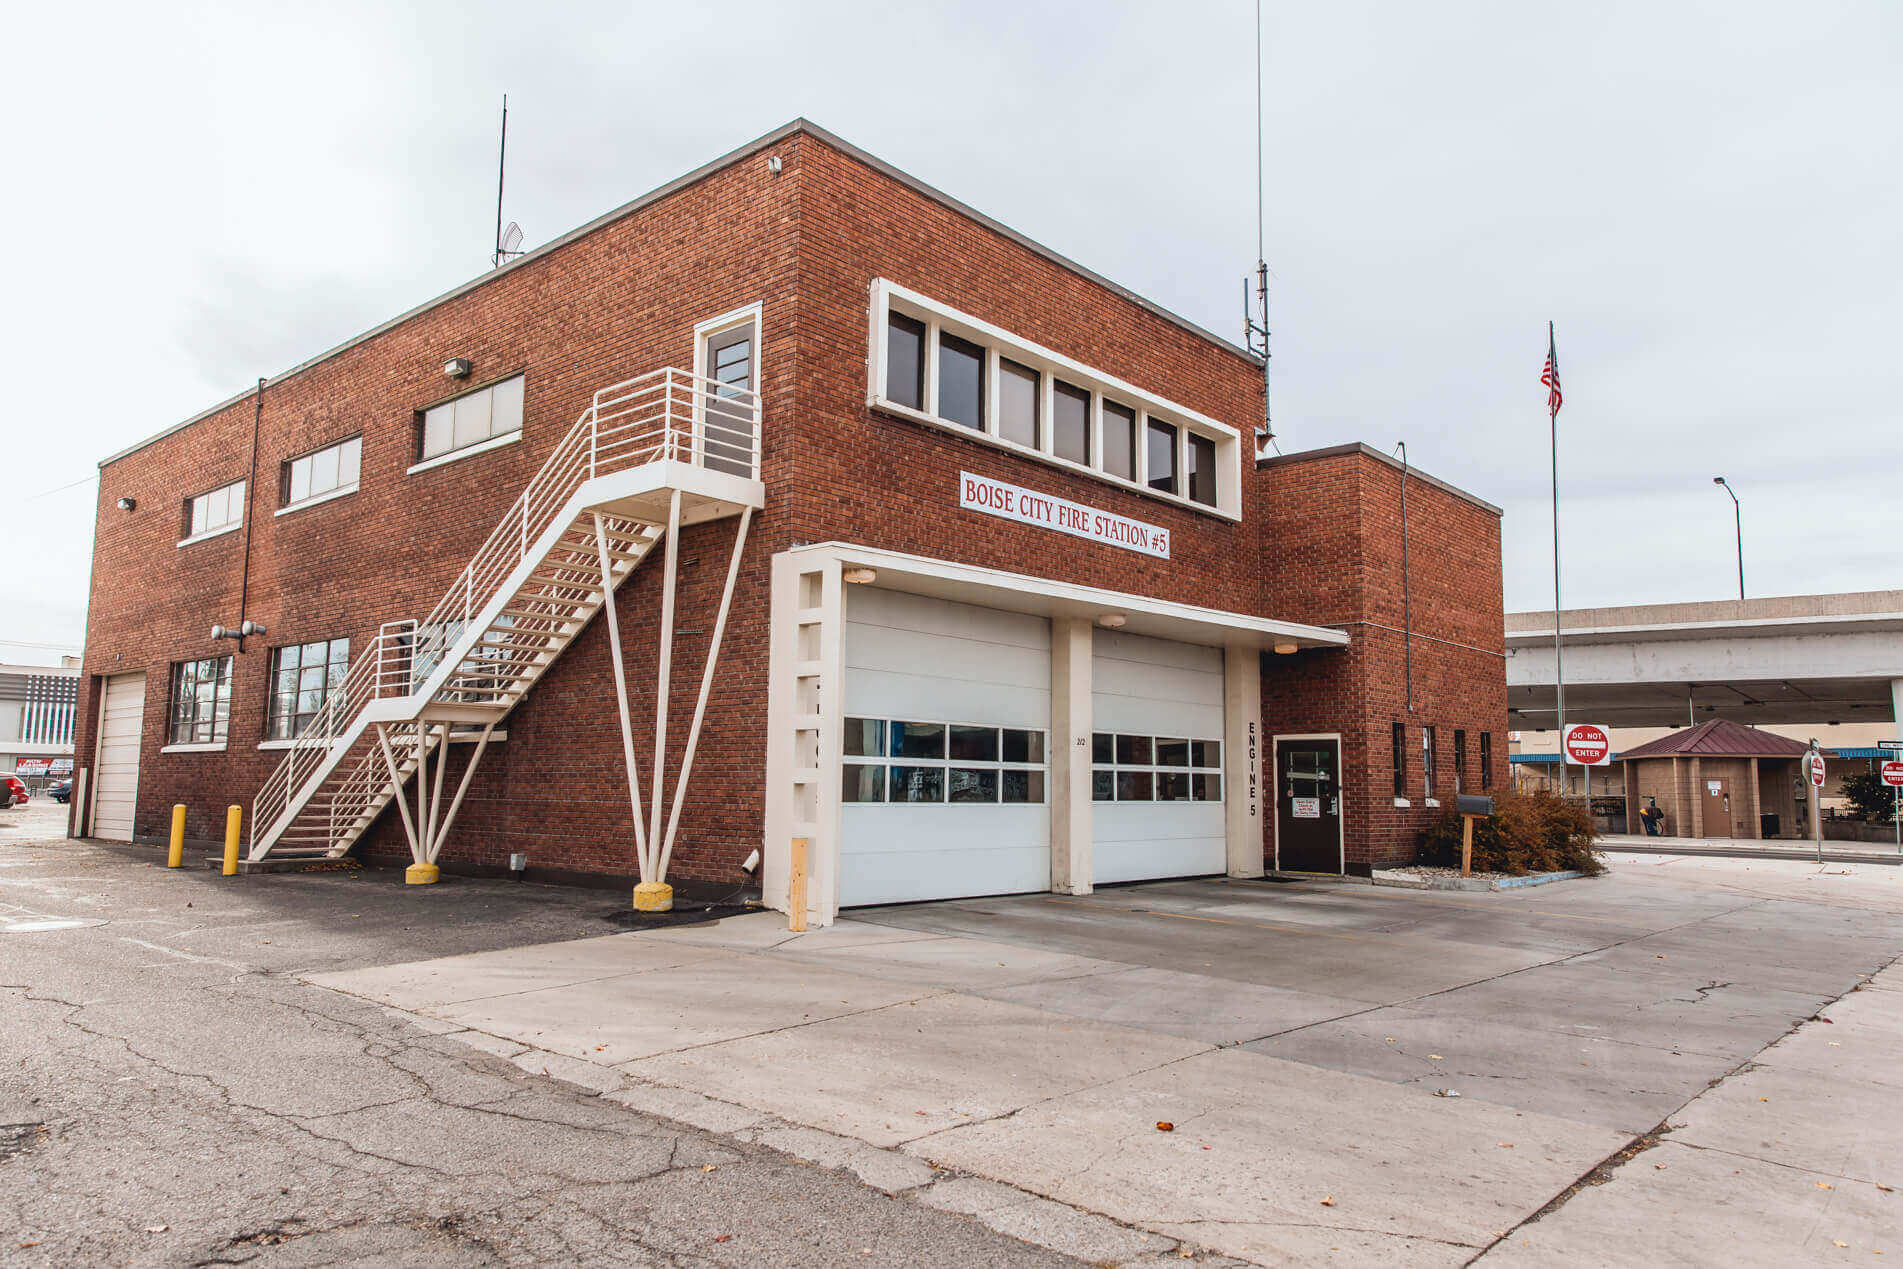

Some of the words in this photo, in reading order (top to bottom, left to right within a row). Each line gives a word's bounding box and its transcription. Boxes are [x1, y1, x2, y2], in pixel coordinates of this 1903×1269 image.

[965, 479, 1014, 513] BOISE
[1020, 495, 1053, 522] CITY
[1058, 505, 1089, 532] FIRE
[1095, 515, 1148, 548] STATION
[1151, 533, 1166, 552] #5
[1572, 731, 1582, 740] DO
[1587, 731, 1602, 740] NOT
[1576, 749, 1600, 757] ENTER
[1248, 722, 1256, 798] ENGINE
[1250, 804, 1256, 816] 5
